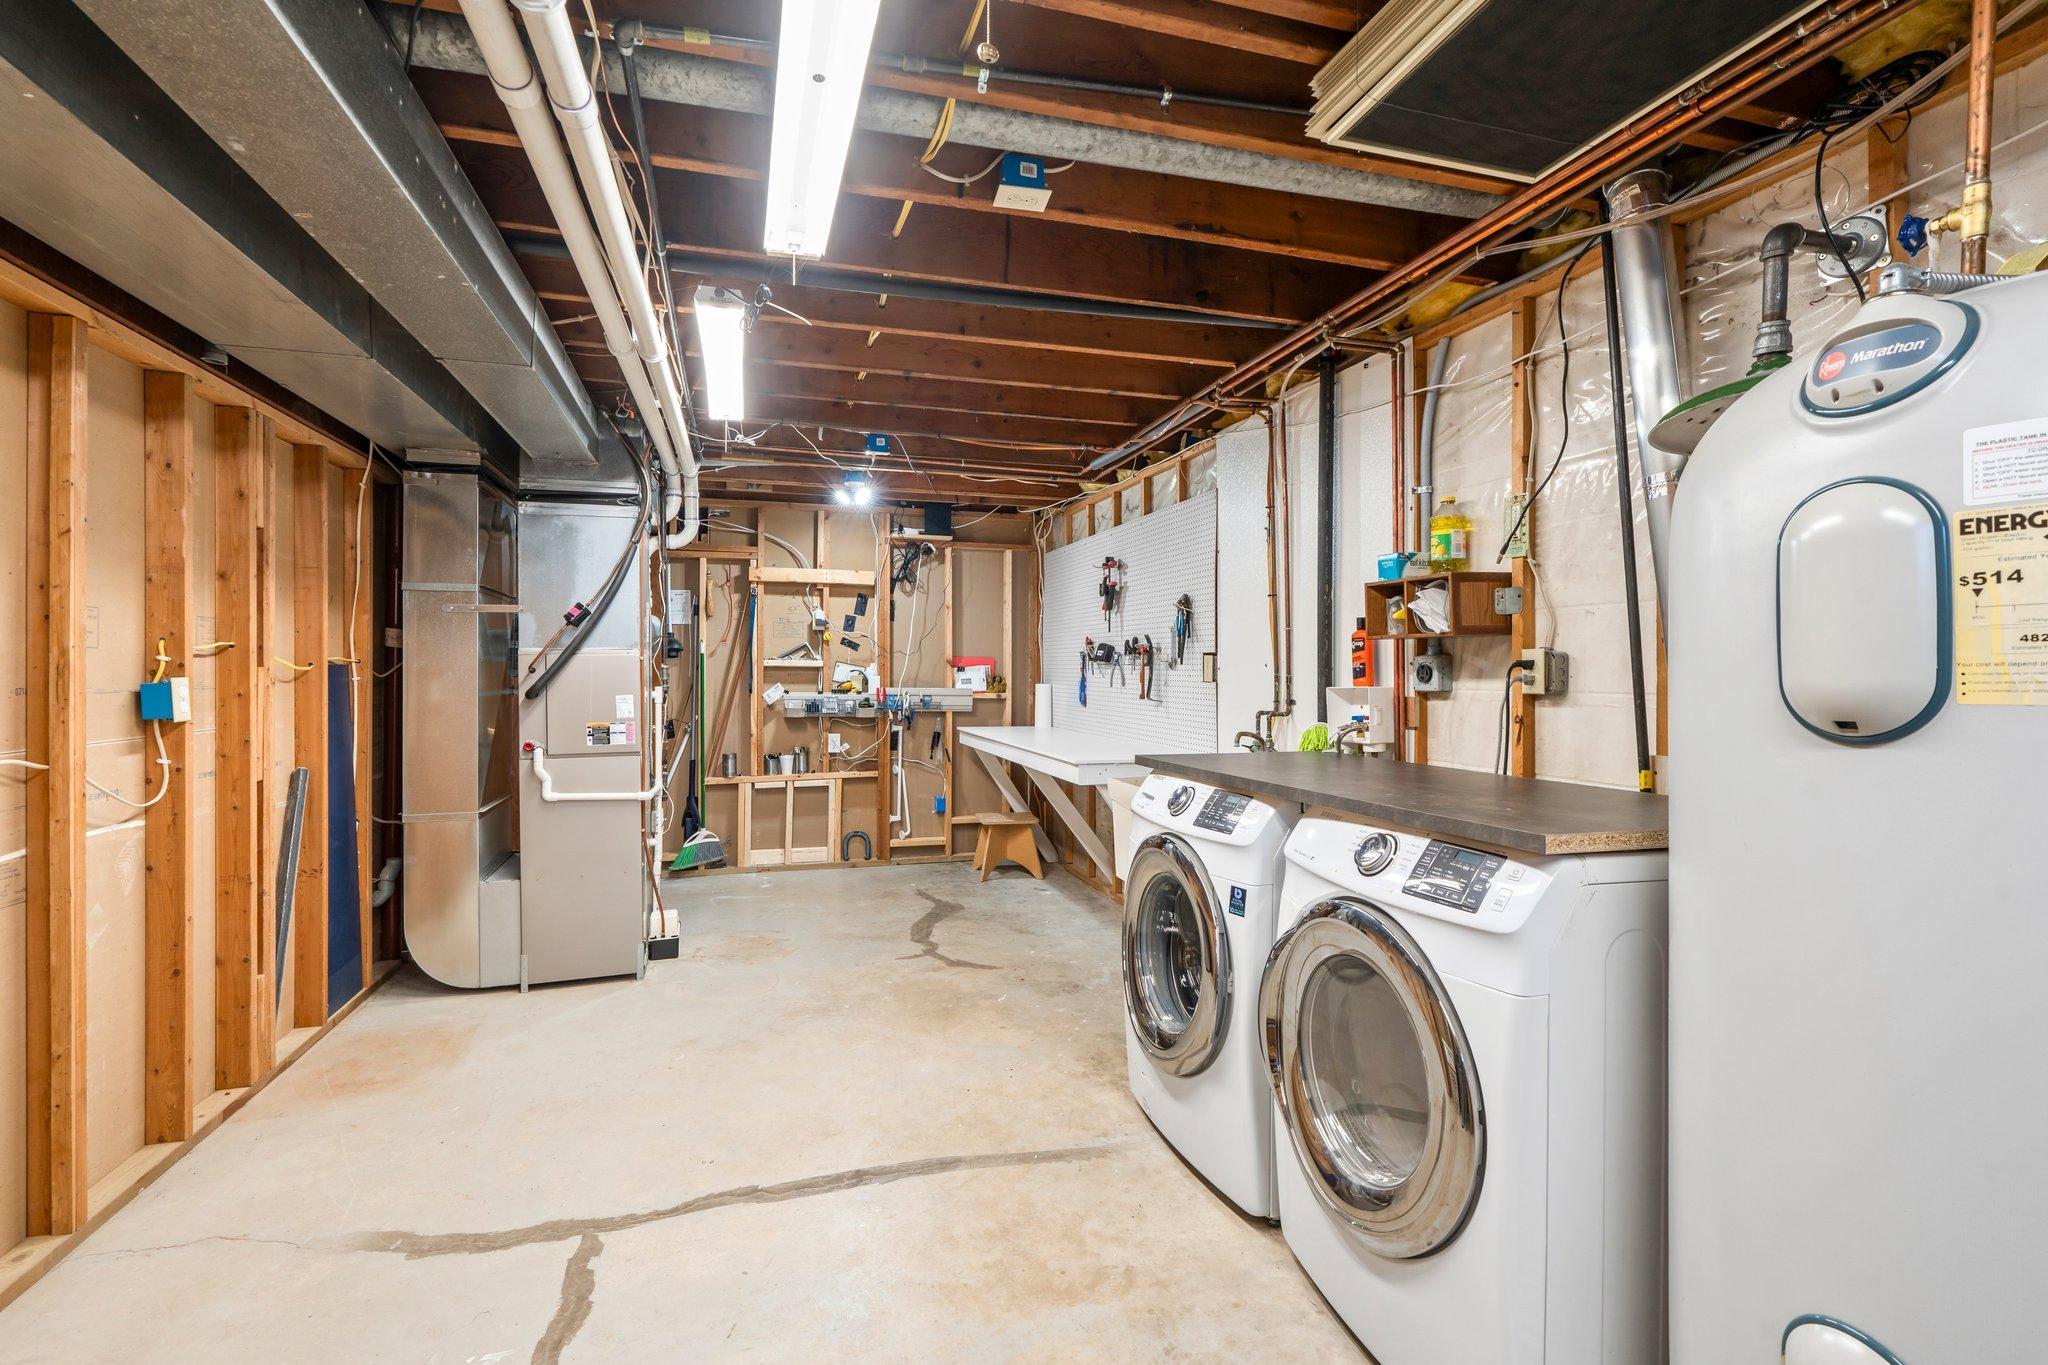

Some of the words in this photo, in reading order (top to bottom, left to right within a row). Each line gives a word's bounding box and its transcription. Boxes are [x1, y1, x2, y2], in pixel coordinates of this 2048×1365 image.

[1818, 356, 1845, 378] Rheem
[1849, 339, 1926, 365] Marathon
[1990, 437, 2018, 445] PLASTIC
[1997, 553, 2038, 562] Estimated
[1959, 569, 2024, 587] $514
